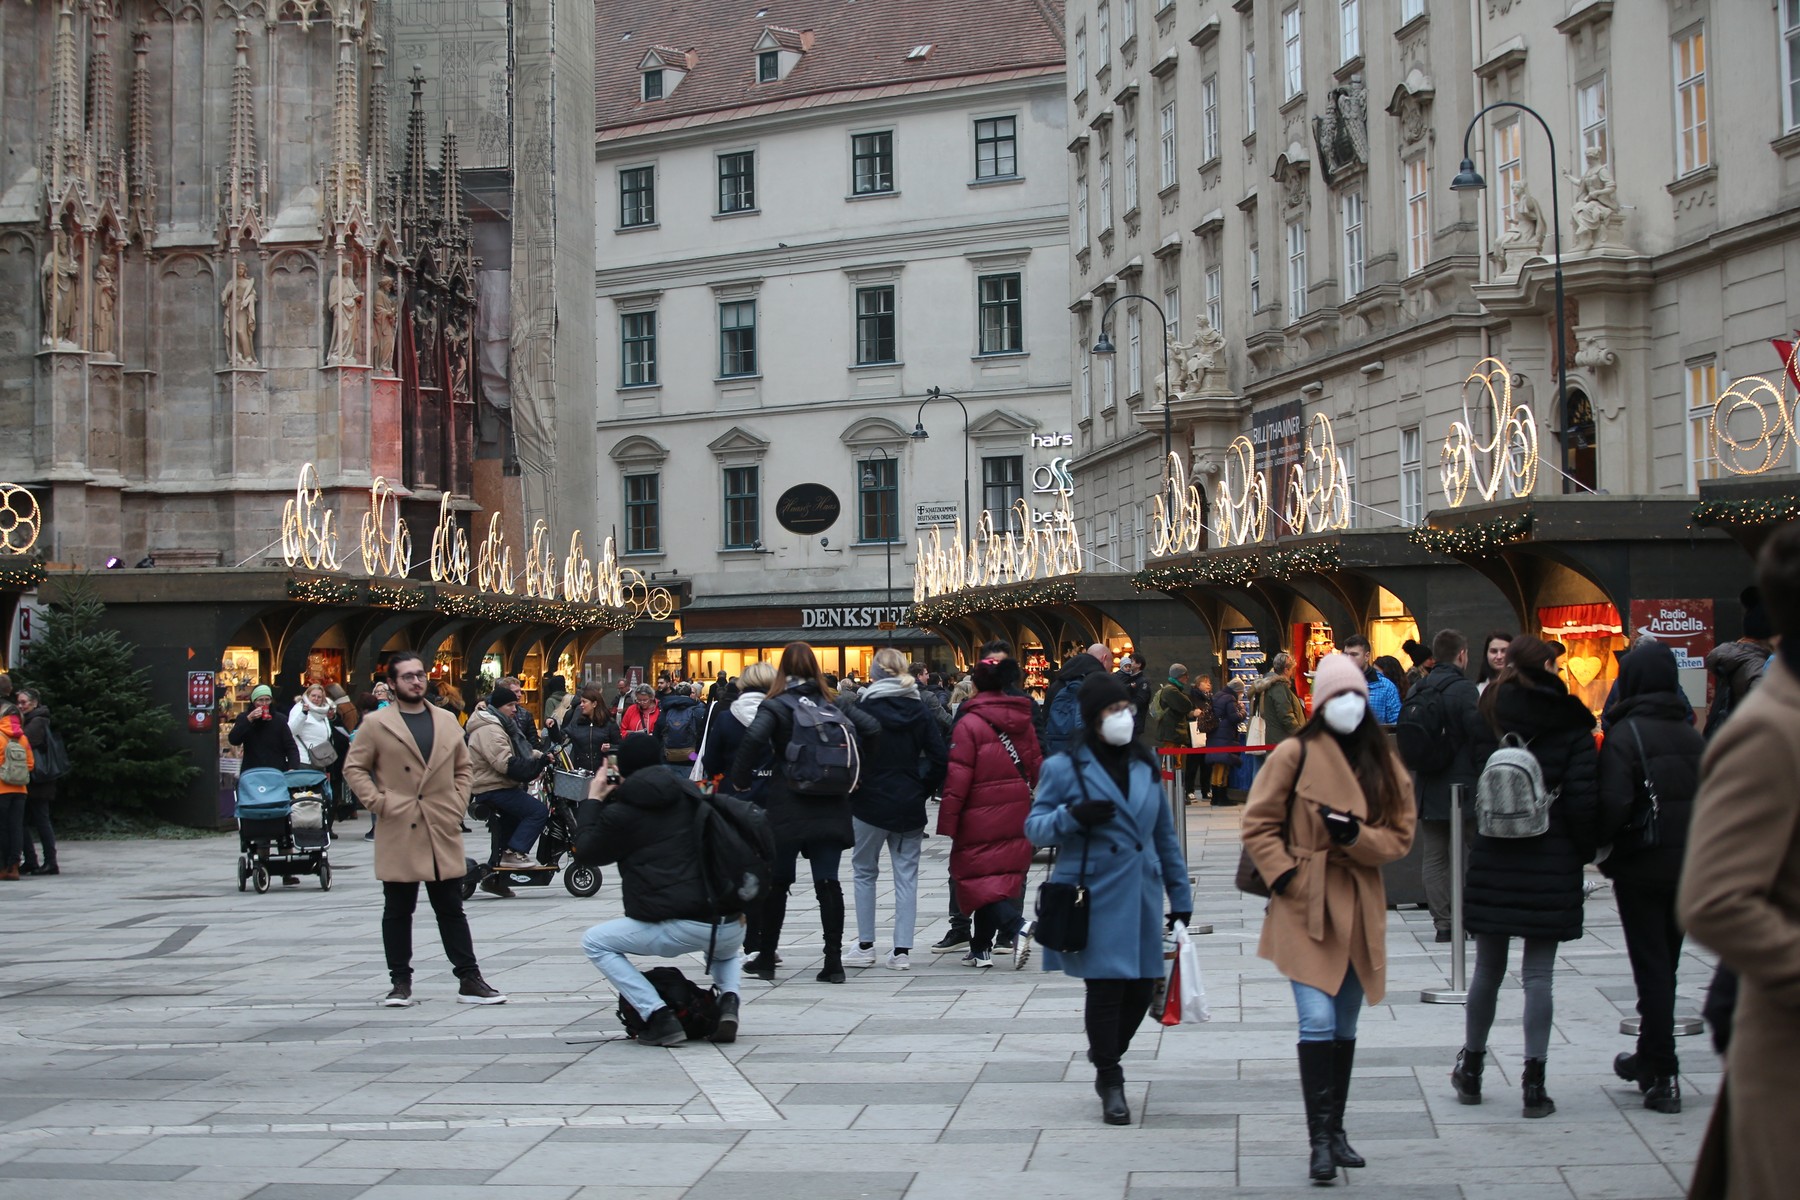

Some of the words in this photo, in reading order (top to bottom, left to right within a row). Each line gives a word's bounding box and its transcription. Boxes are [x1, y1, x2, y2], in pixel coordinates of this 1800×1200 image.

[1031, 432, 1073, 447] hairs
[801, 606, 911, 628] DENKSTEI
[1660, 609, 1687, 619] Radio
[1677, 659, 1702, 668] chten
[999, 732, 1020, 764] HAPPY
